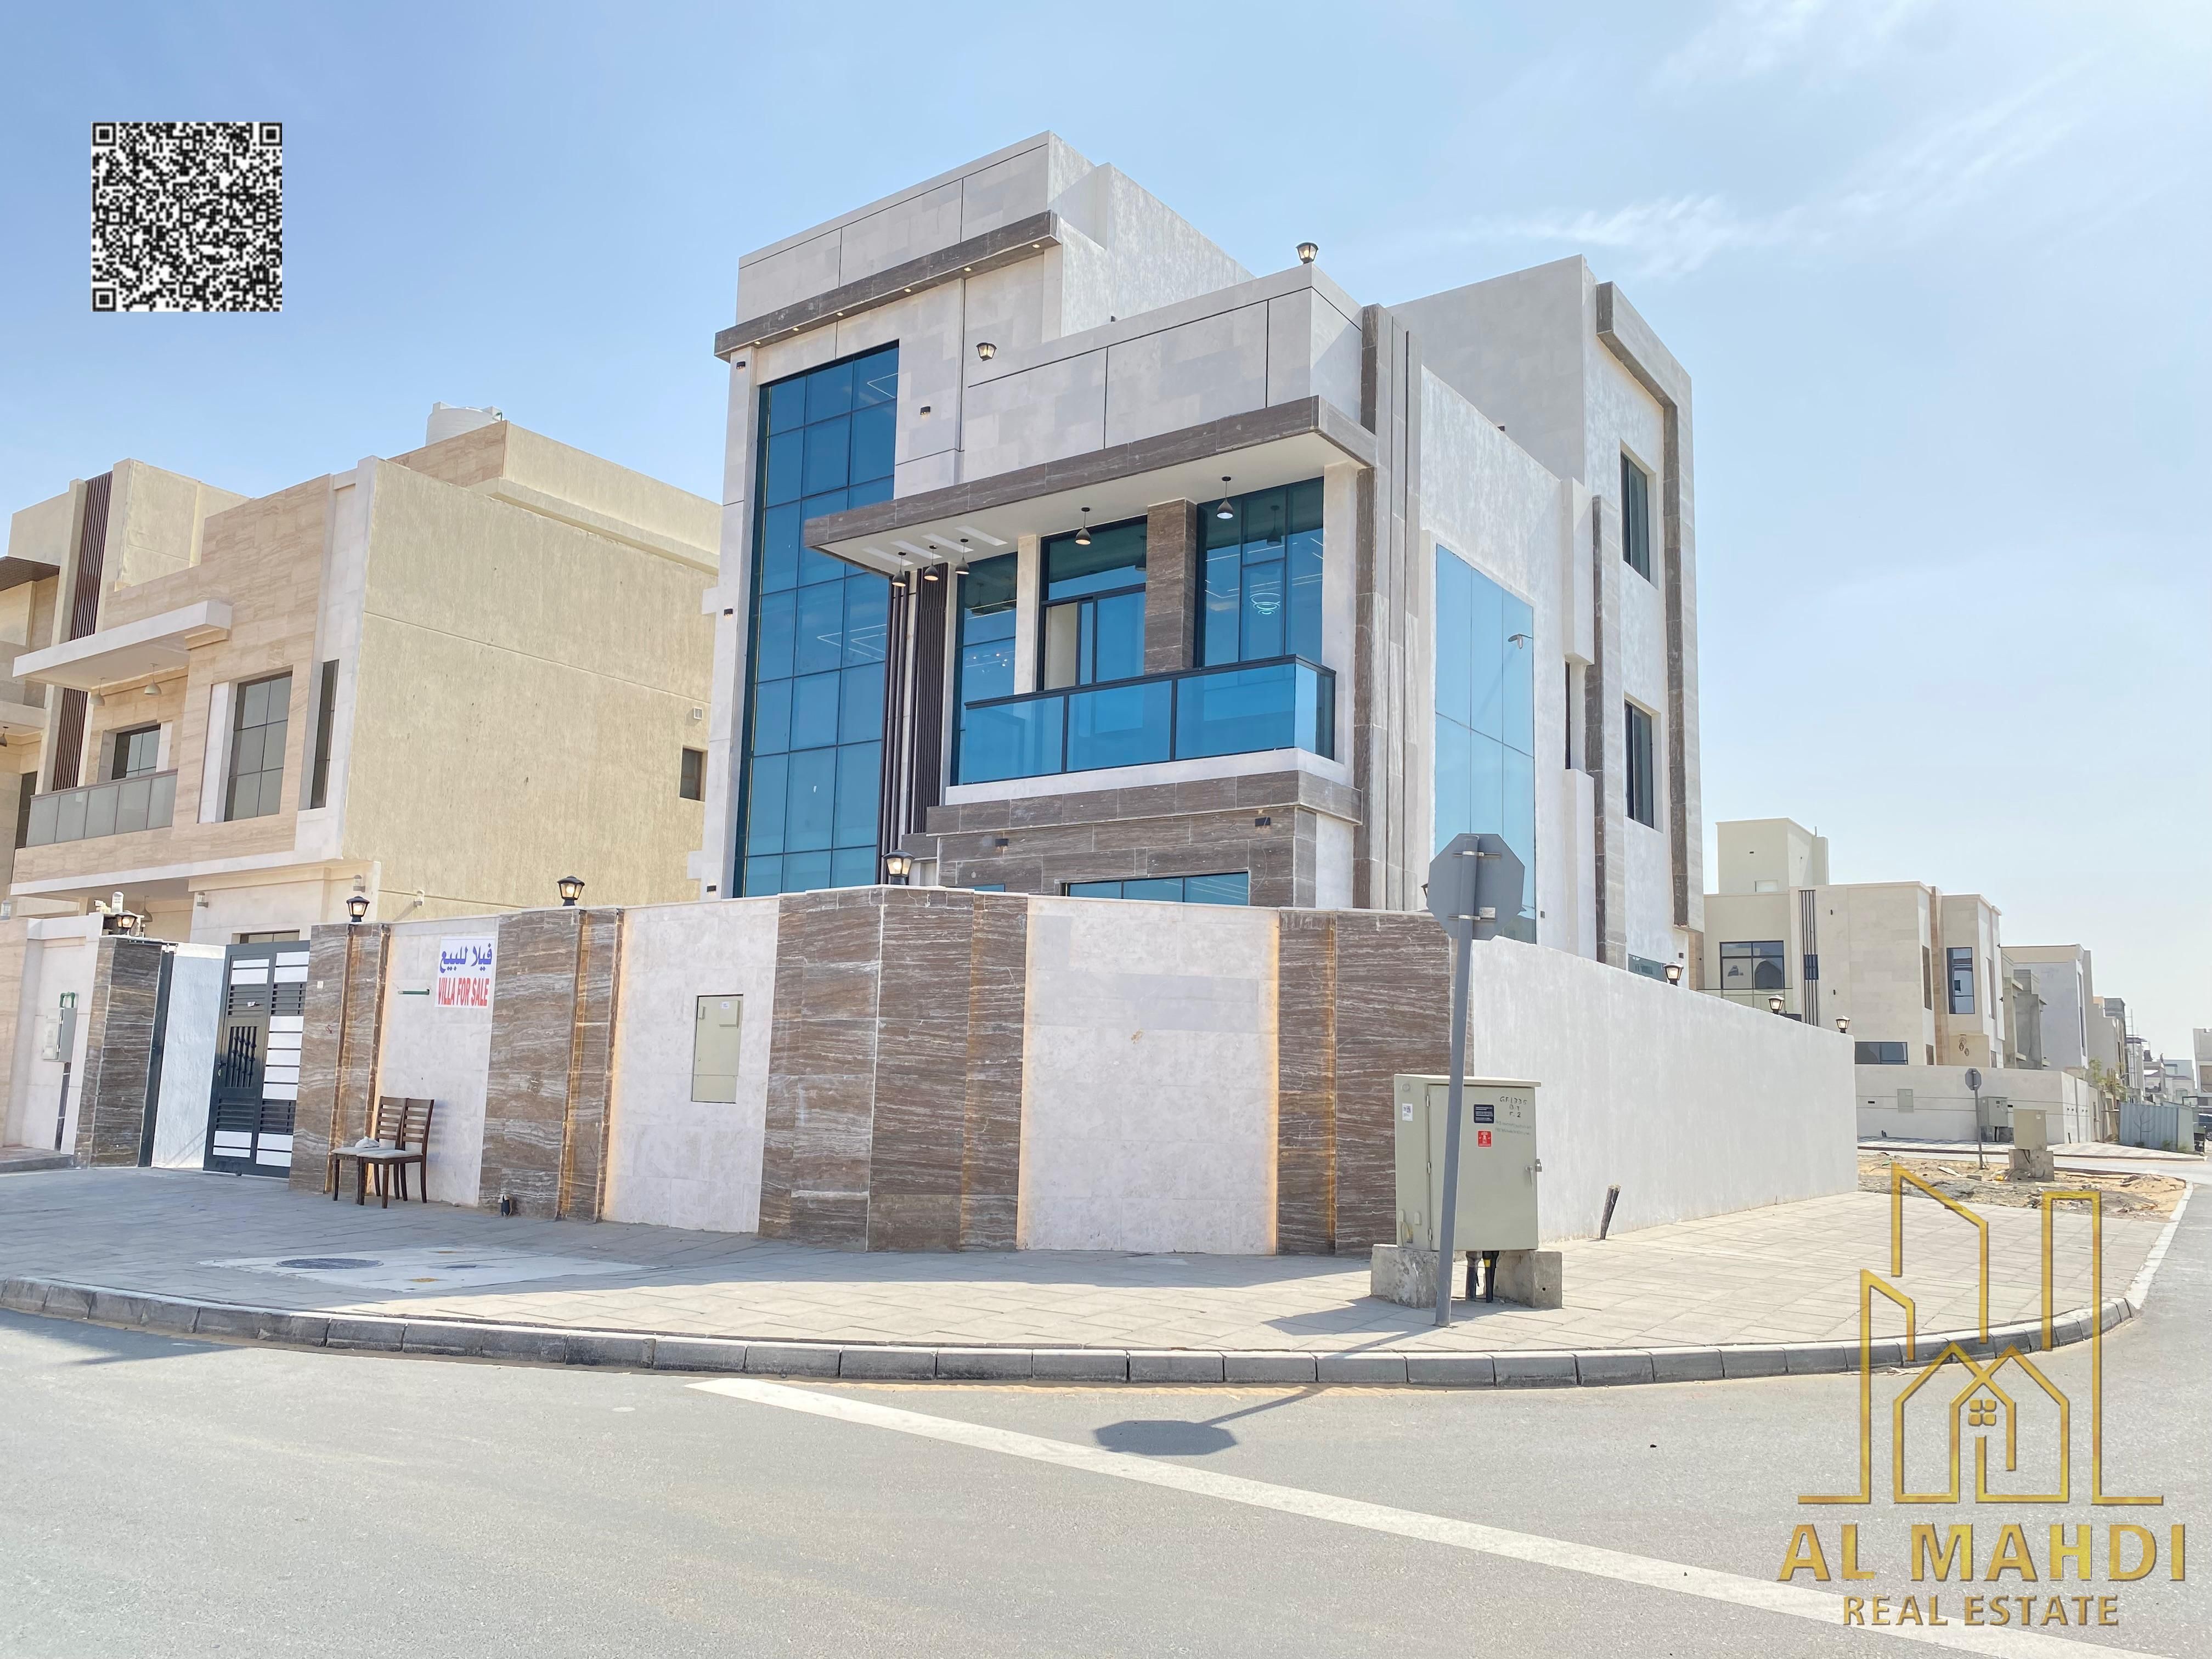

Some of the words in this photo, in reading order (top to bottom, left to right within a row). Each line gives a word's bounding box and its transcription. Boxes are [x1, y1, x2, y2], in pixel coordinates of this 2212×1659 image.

[440, 945, 468, 973] للبيع
[471, 943, 493, 971] فيلا
[438, 978, 455, 1006] VILLA
[456, 978, 471, 1006] FOR
[471, 978, 489, 1006] SALE
